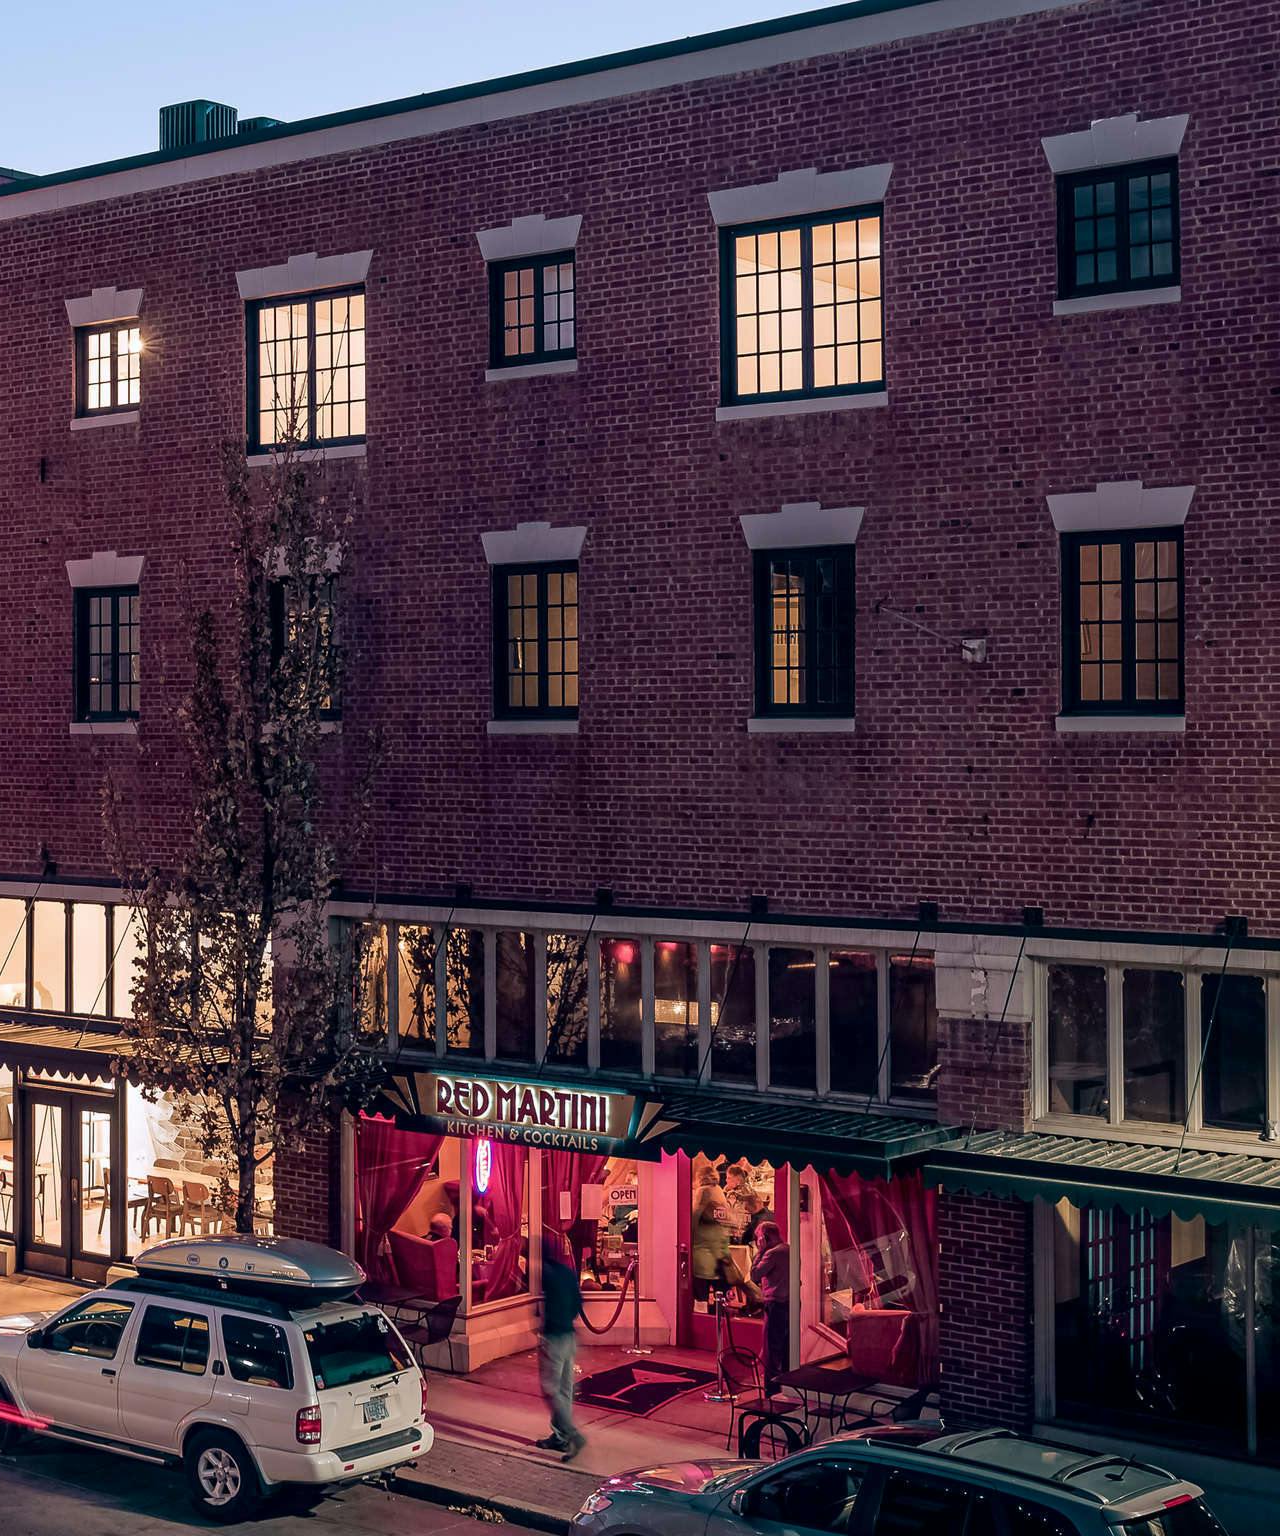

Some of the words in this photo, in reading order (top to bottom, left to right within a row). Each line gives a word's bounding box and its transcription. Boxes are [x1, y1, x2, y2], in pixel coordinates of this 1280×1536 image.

[436, 1077, 490, 1118] RED
[496, 1082, 608, 1133] MARTINI
[447, 1120, 505, 1140] KITCHEN
[509, 1128, 520, 1141] &
[523, 1129, 599, 1151] COCKTAILS
[610, 1189, 636, 1200] OPEN
